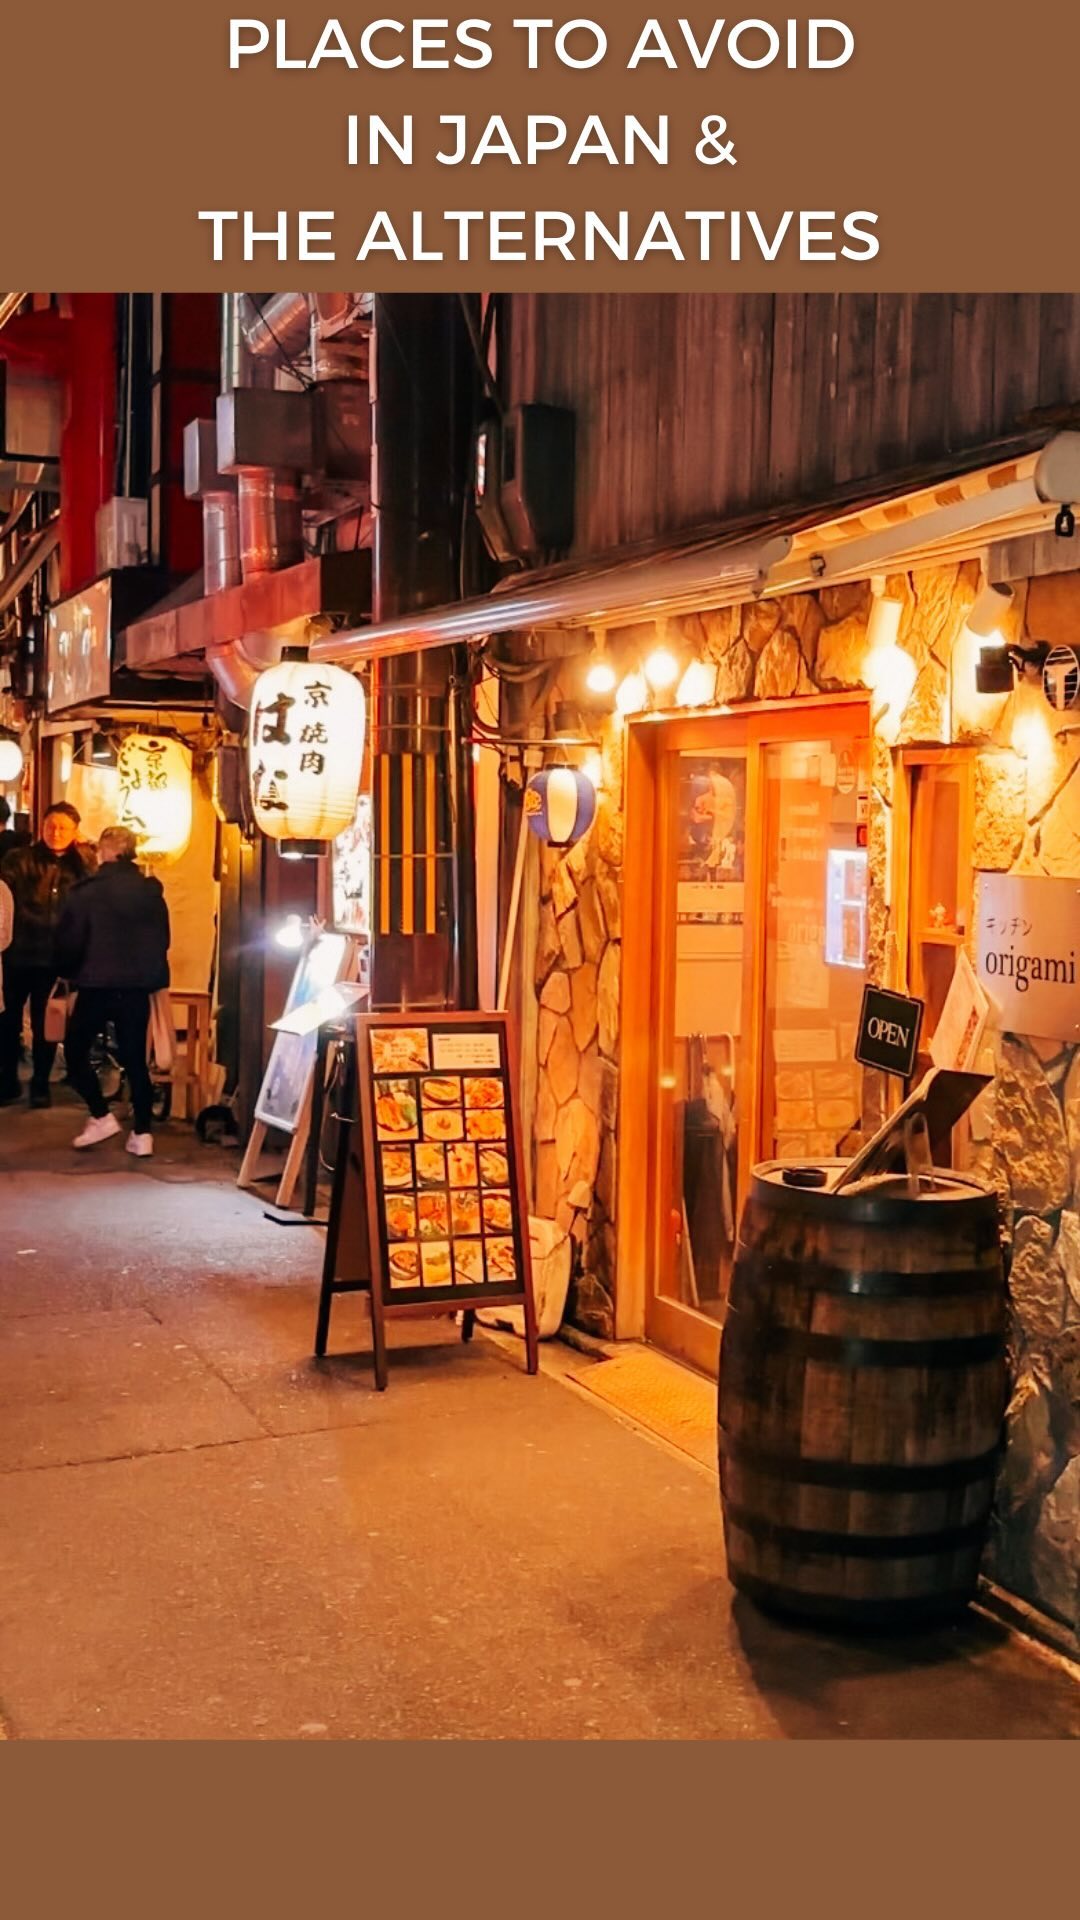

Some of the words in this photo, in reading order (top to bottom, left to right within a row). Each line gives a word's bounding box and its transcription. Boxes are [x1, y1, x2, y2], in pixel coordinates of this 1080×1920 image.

[299, 680, 332, 776] 京焼肉
[985, 917, 1033, 937] キッチン
[985, 945, 1077, 993] origami
[867, 1016, 911, 1049] OPEN
